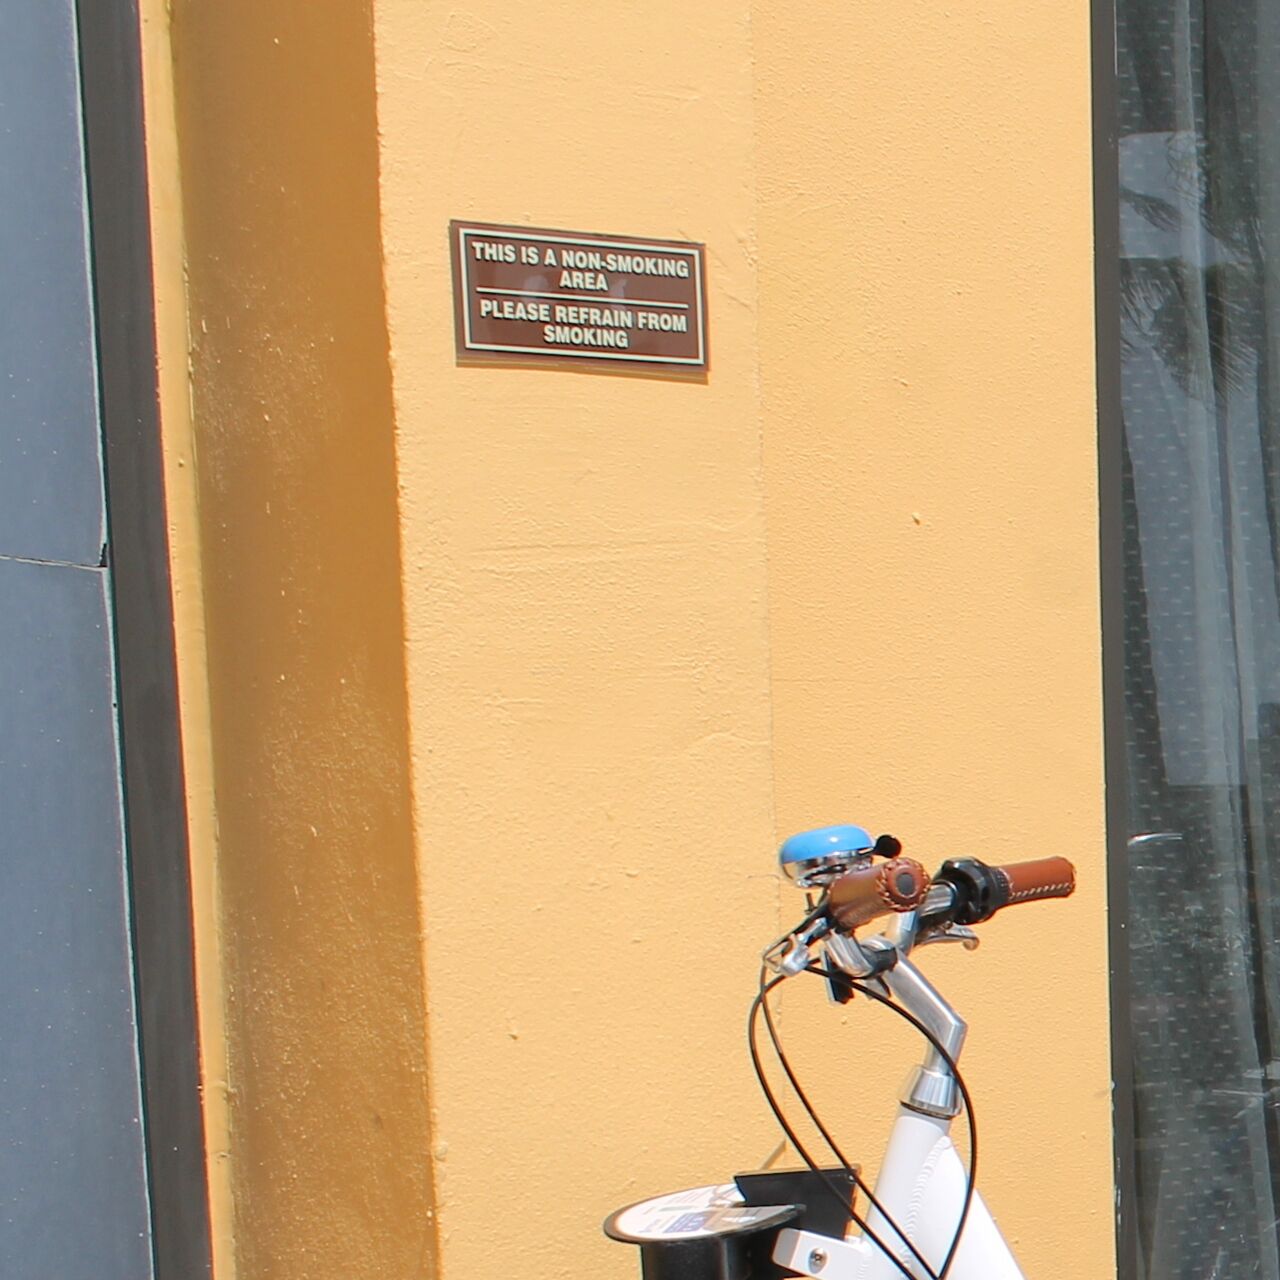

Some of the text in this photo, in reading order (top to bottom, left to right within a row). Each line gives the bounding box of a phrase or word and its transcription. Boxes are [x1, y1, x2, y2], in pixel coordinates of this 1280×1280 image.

[471, 241, 690, 278] THIS IS A NON-SMOKING
[559, 270, 609, 291] AREA
[480, 298, 687, 333] PLEASE REFRAIN FROM
[543, 323, 629, 349] SMOKING
